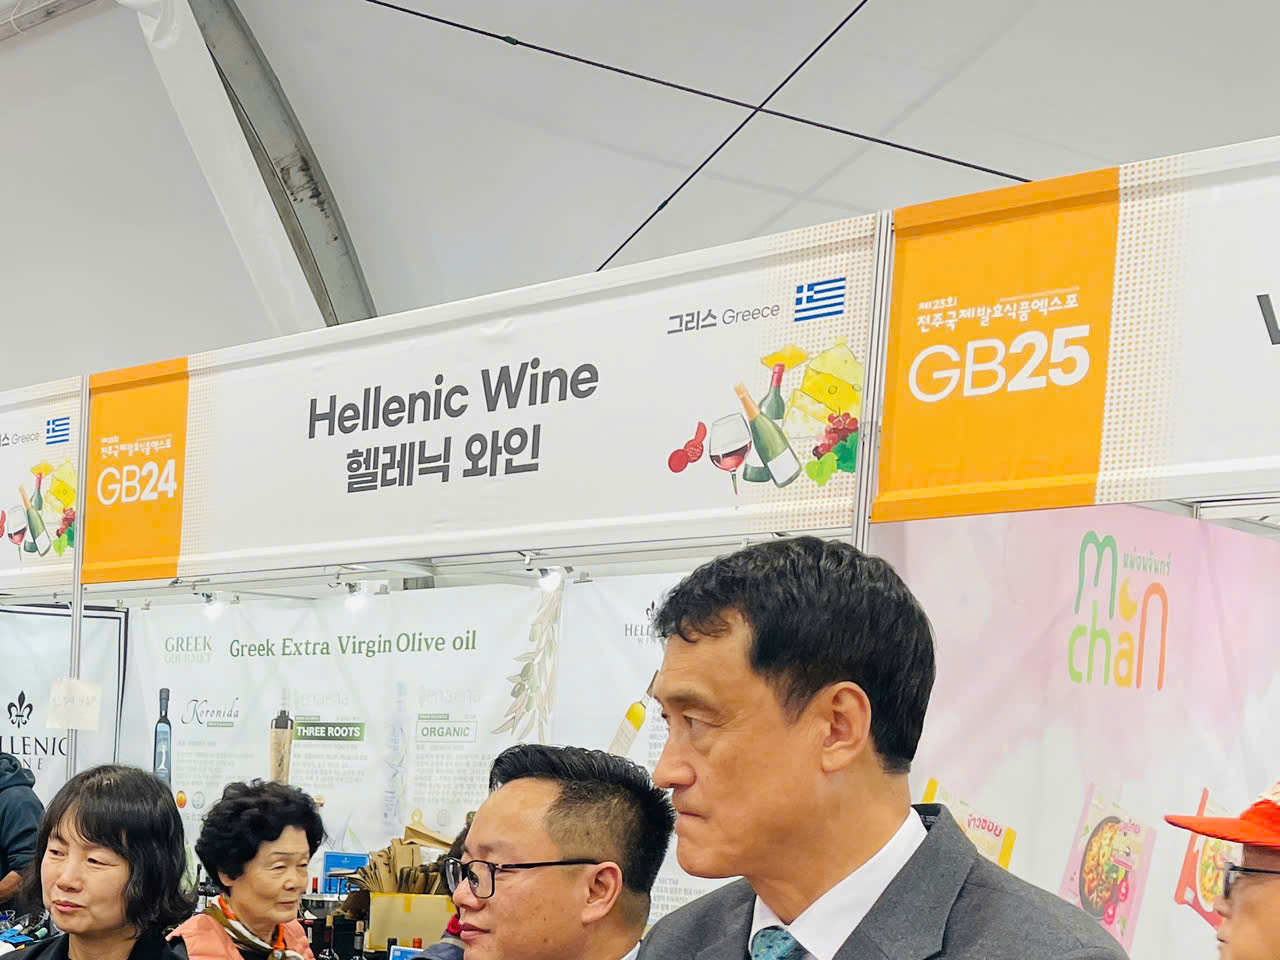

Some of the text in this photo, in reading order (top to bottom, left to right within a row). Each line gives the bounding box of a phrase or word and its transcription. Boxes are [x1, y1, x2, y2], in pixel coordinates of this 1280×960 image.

[667, 302, 780, 335] 그리스 Greece
[917, 294, 1079, 333] 전주국제발효식품엑스포
[908, 324, 1091, 402] GB25
[308, 357, 599, 439] Hellenic Wine
[11, 430, 40, 446] Greece
[347, 424, 540, 493] 헬레닉 와인
[97, 459, 177, 505] GB24
[164, 635, 214, 652] GREEK
[230, 630, 477, 660] Greek Extra Virgin Olive oil
[181, 698, 239, 725] Koronida
[296, 726, 361, 737] THREE ROOTS
[421, 726, 470, 738] ORGANIC
